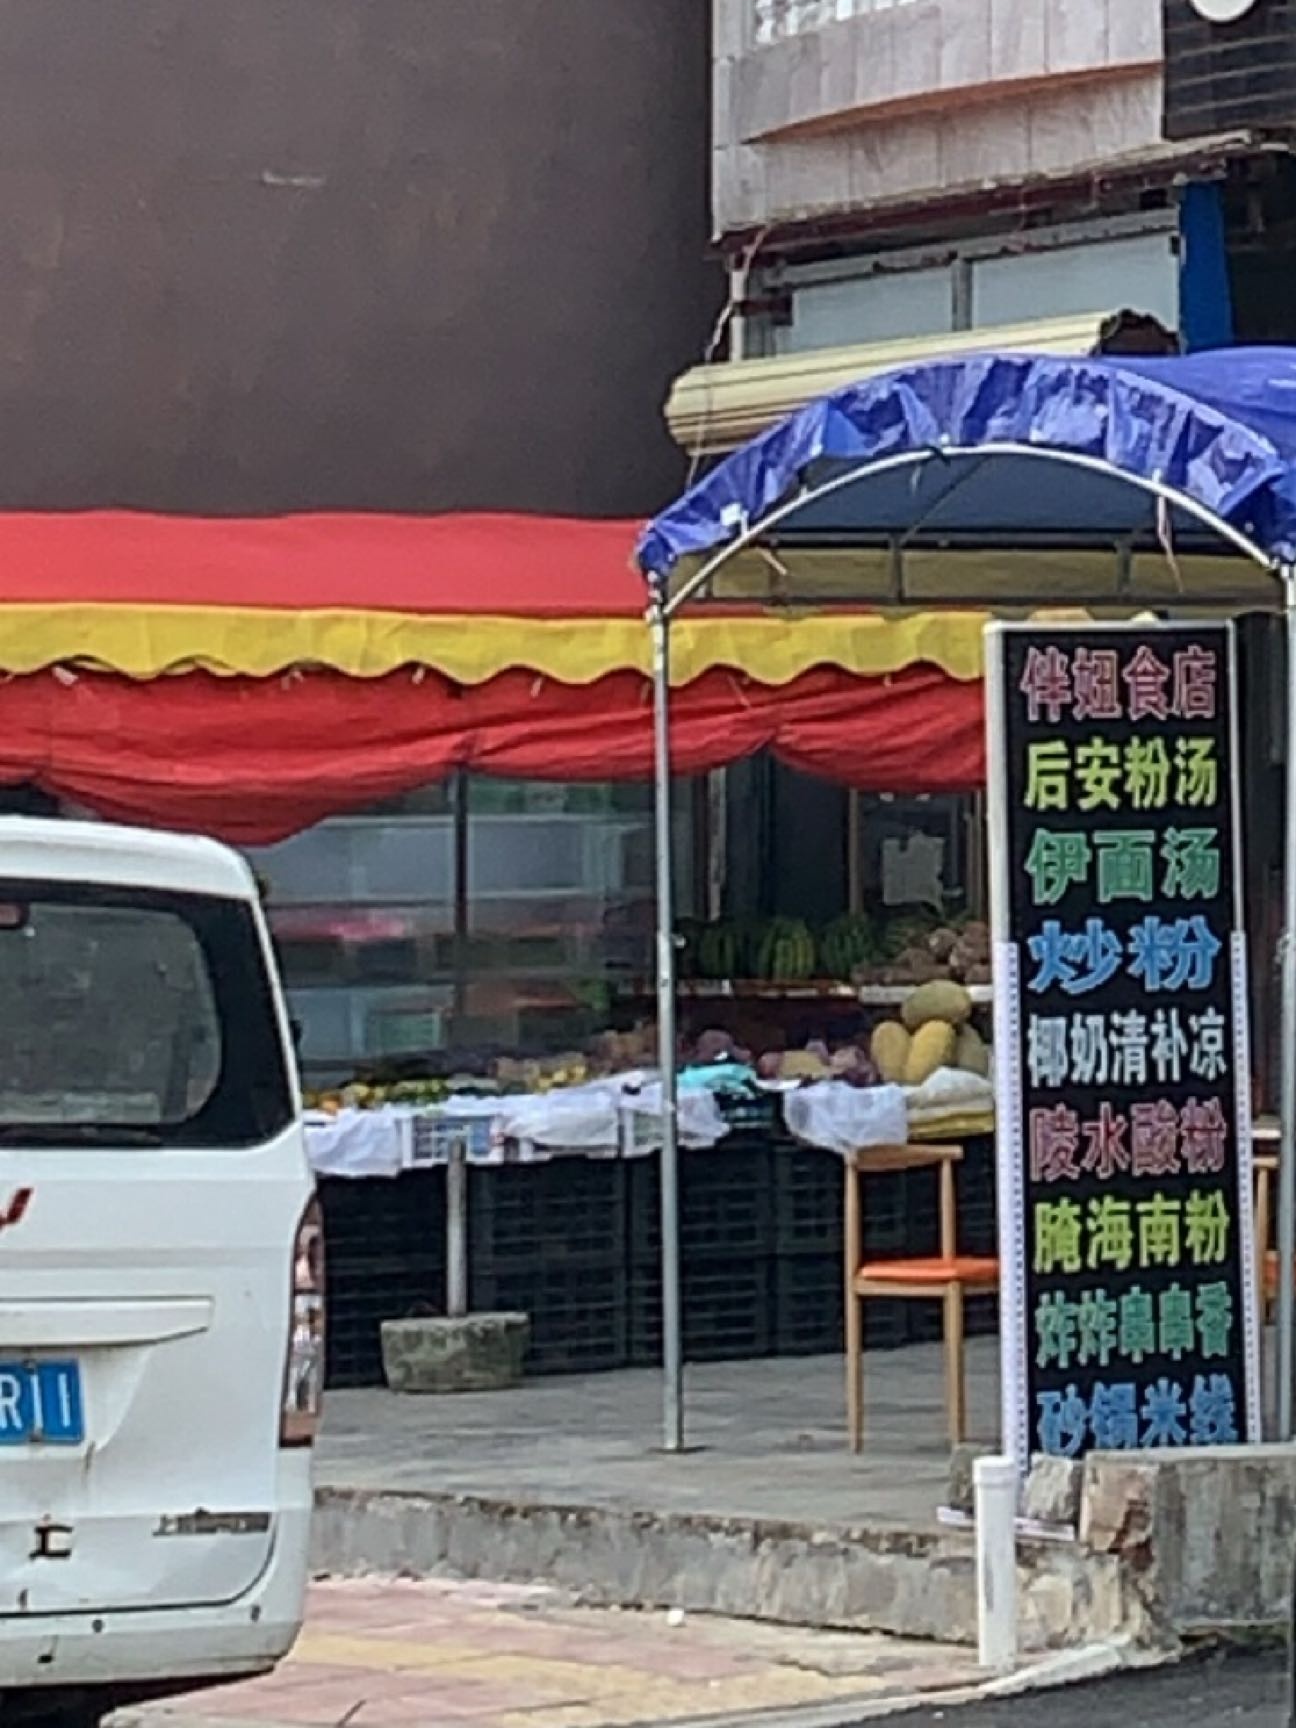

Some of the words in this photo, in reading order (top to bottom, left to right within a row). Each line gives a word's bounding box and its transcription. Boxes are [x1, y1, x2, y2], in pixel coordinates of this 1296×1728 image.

[1020, 645, 1217, 722] 伴妞食店
[1024, 736, 1218, 810] 后安粉汤
[1024, 827, 1221, 906] 伊面汤
[1027, 915, 1222, 995] 炒粉
[1027, 1005, 1228, 1088] 椰奶清补凉
[1029, 1096, 1228, 1182] 陵水酸粉
